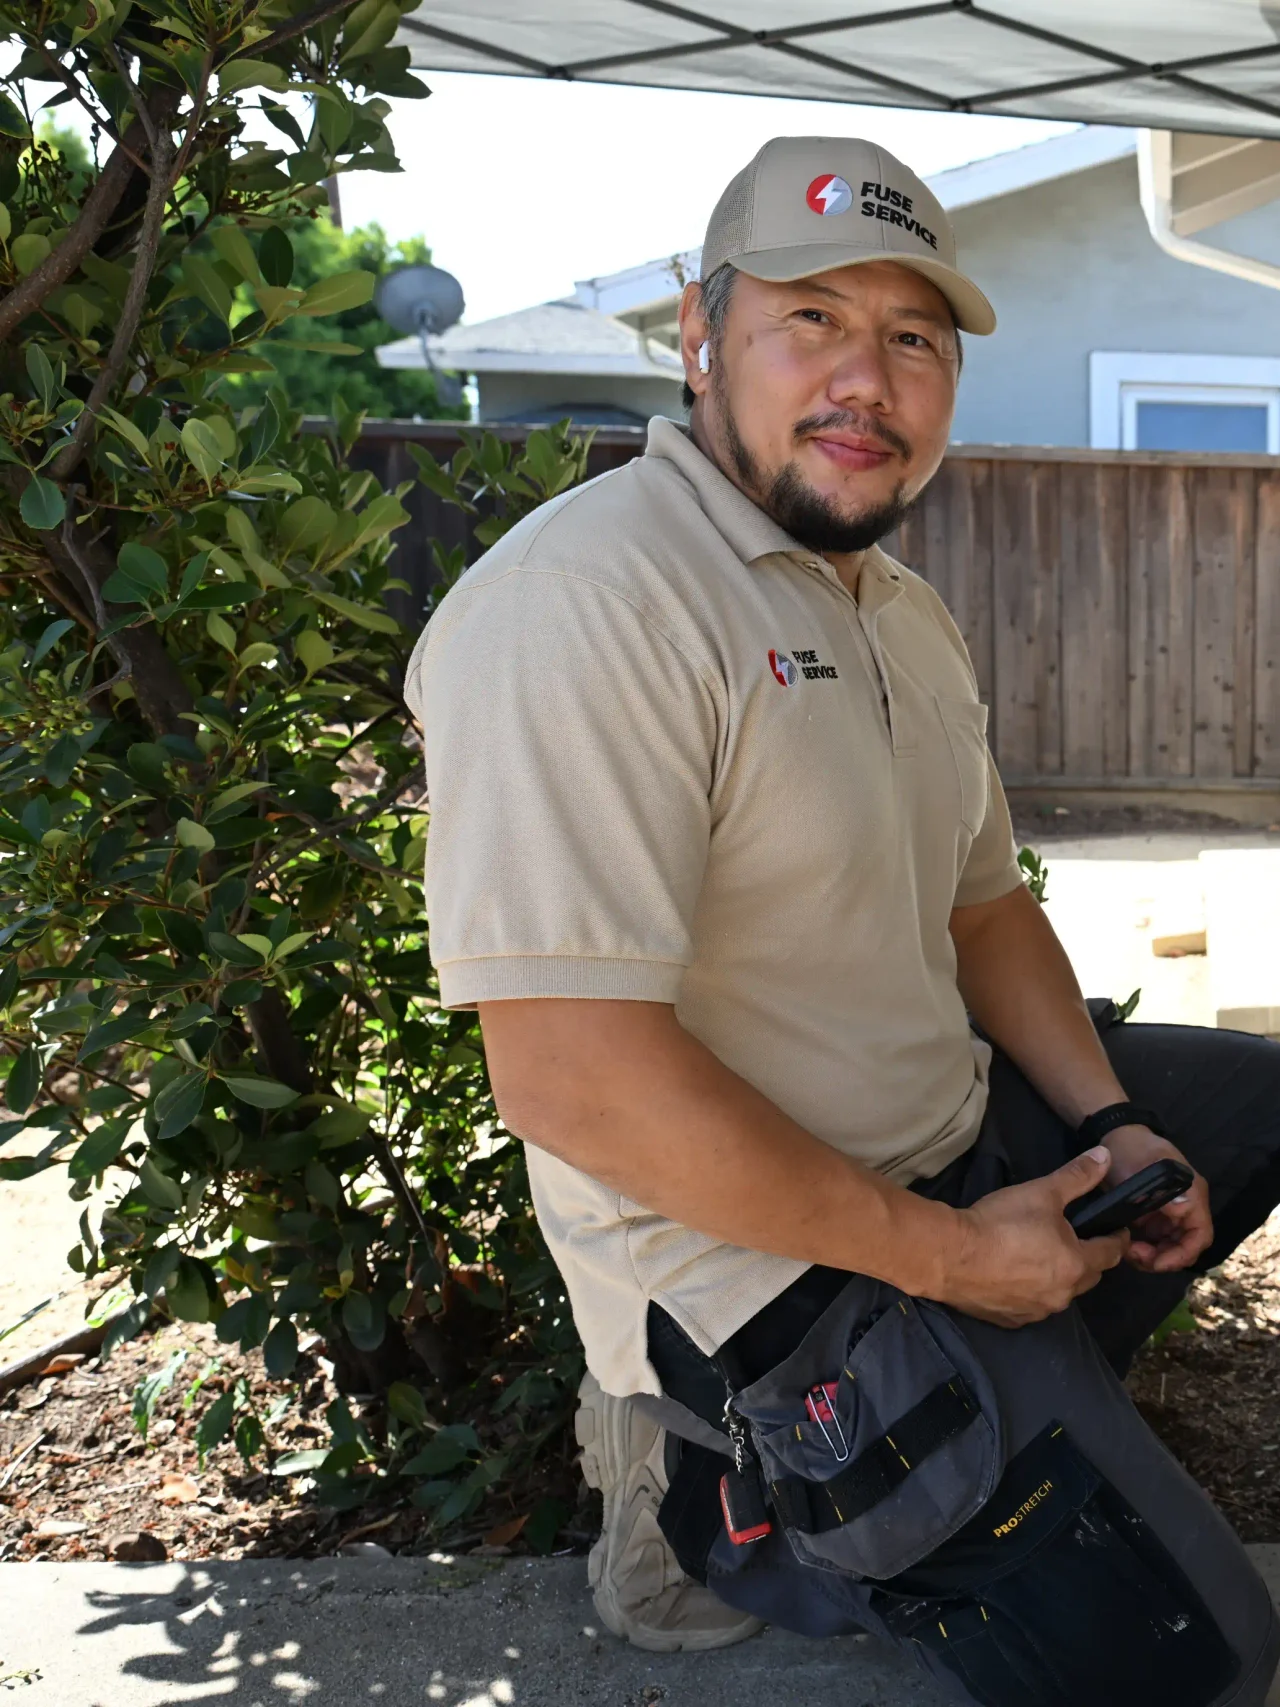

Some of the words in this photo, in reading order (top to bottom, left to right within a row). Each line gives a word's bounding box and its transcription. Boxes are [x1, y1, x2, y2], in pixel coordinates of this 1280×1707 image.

[860, 181, 913, 213] FUSE
[860, 201, 937, 250] SERVICE
[791, 649, 819, 664] FUSE
[801, 665, 839, 680] SERVICE
[993, 1479, 1053, 1537] PROSTRETCH
